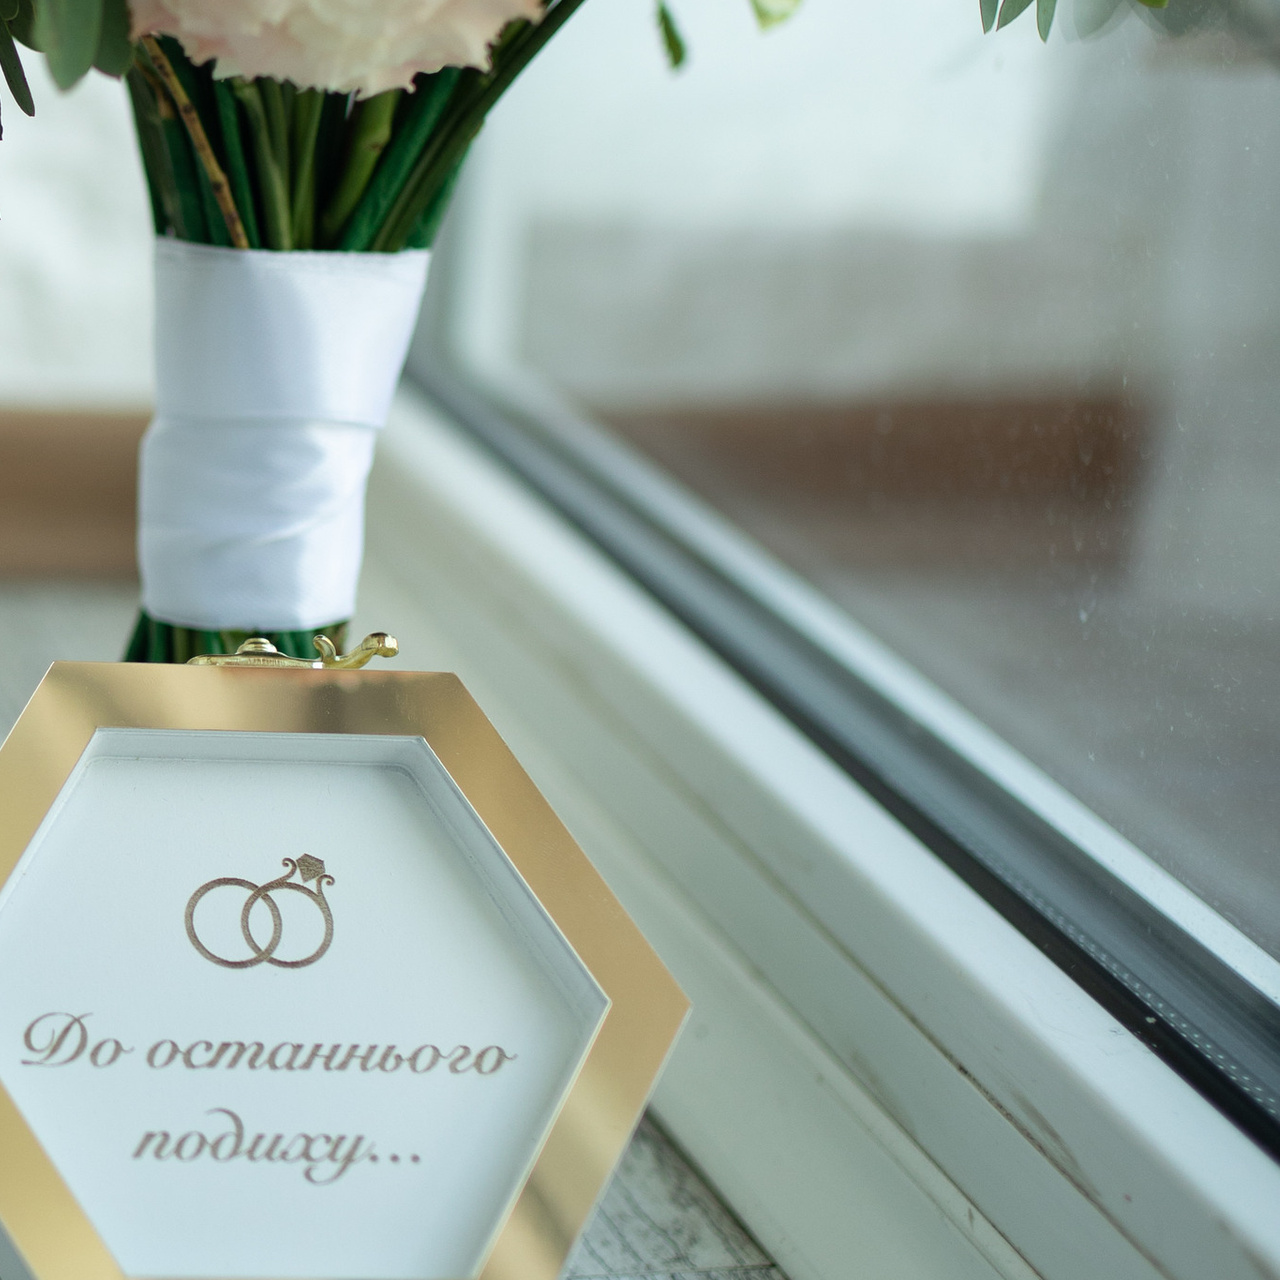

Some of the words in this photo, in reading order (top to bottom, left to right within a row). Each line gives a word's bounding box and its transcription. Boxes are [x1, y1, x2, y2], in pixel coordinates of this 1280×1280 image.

[21, 1011, 134, 1068] До
[145, 1039, 518, 1075] останнього
[131, 1107, 422, 1185] подиху...
